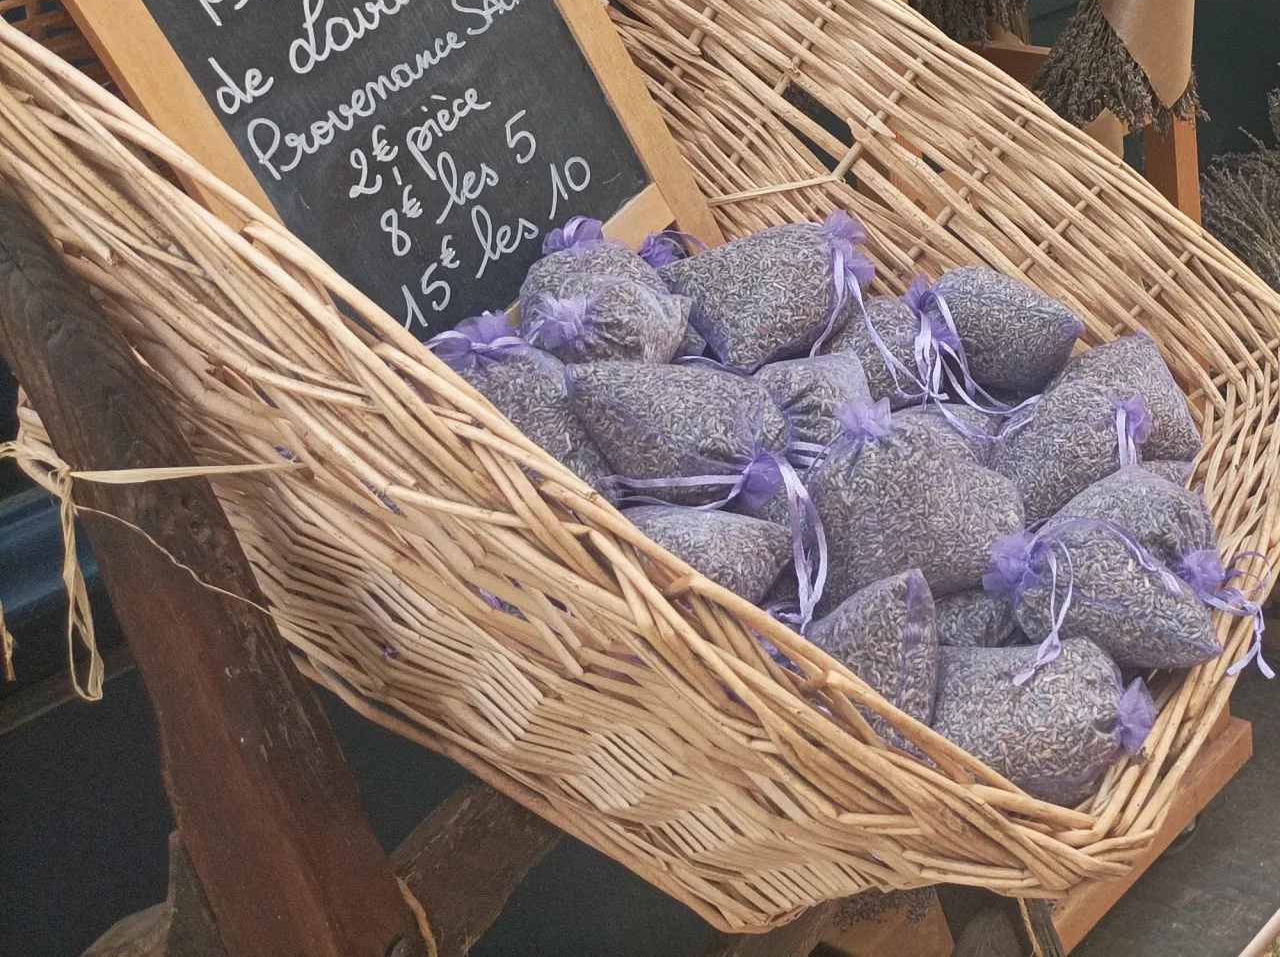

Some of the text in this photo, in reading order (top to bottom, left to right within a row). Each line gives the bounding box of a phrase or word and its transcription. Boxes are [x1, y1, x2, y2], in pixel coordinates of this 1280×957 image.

[208, 57, 274, 115] de
[247, 29, 467, 181] Provenance
[436, 151, 500, 225] les
[504, 109, 537, 164] 5
[475, 204, 540, 279] les
[548, 155, 592, 220] 10
